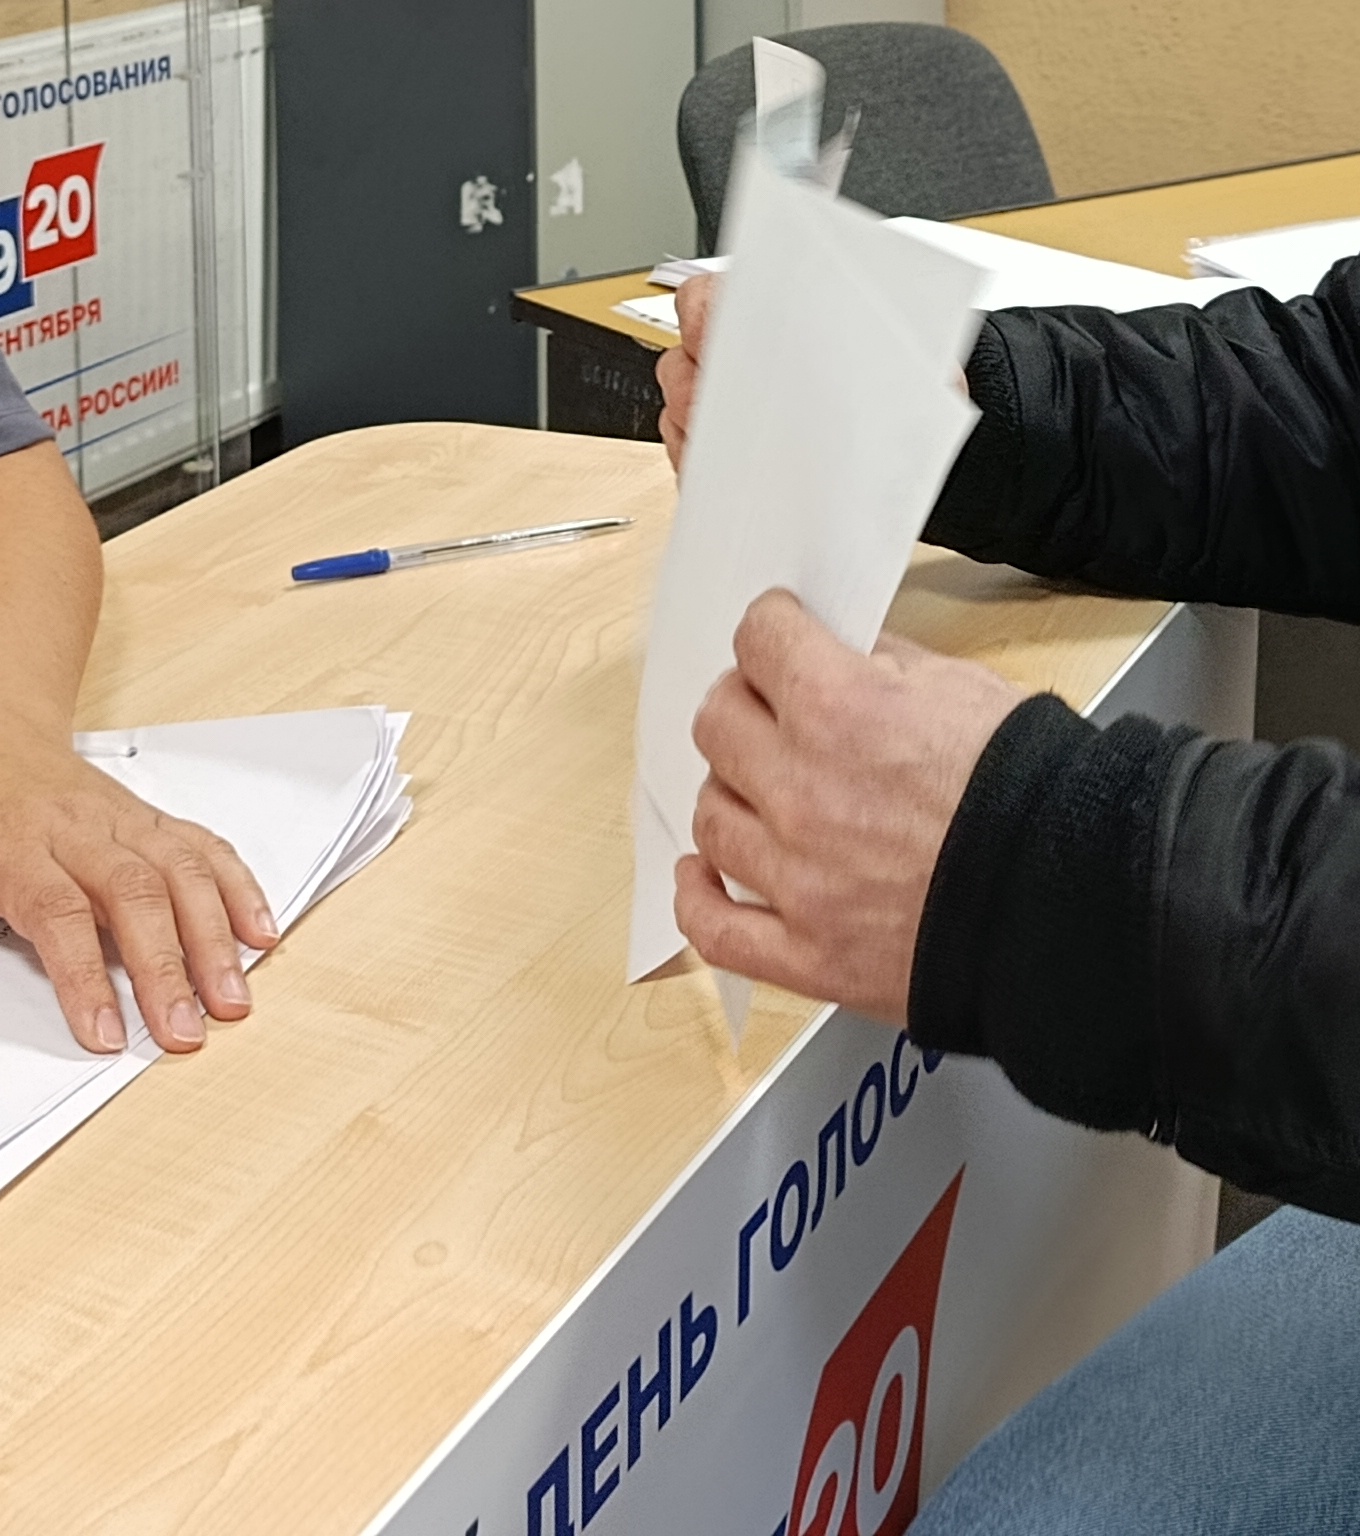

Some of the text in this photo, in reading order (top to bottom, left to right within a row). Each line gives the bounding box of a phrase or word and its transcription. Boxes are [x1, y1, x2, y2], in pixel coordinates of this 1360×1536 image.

[27, 174, 92, 251] 20
[42, 361, 180, 431] ЛА РОССИИ!
[526, 1028, 946, 1536] ДЕНЬ ГОЛОС
[797, 1324, 922, 1536] 20
